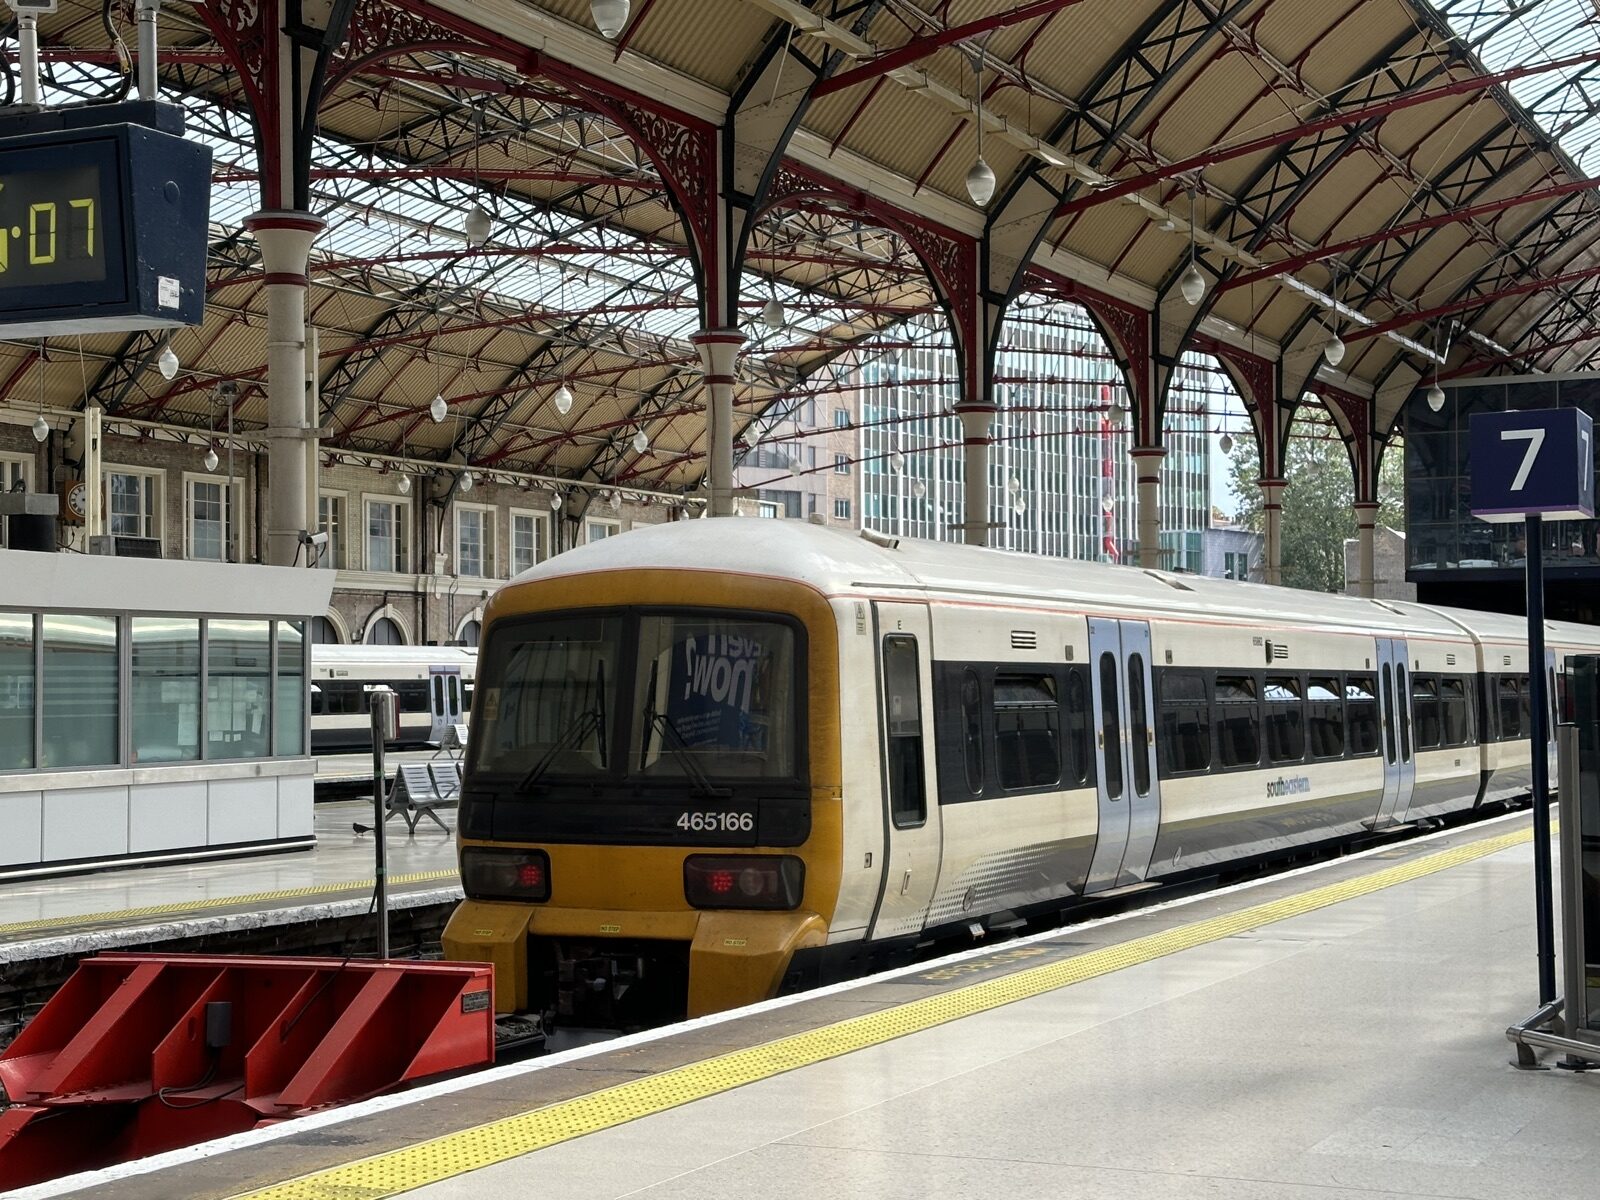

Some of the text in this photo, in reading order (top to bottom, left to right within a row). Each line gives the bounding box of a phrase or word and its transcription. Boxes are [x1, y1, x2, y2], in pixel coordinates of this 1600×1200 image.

[1500, 428, 1546, 491] 7
[1266, 775, 1311, 799] southeastern
[676, 812, 754, 831] 465166
